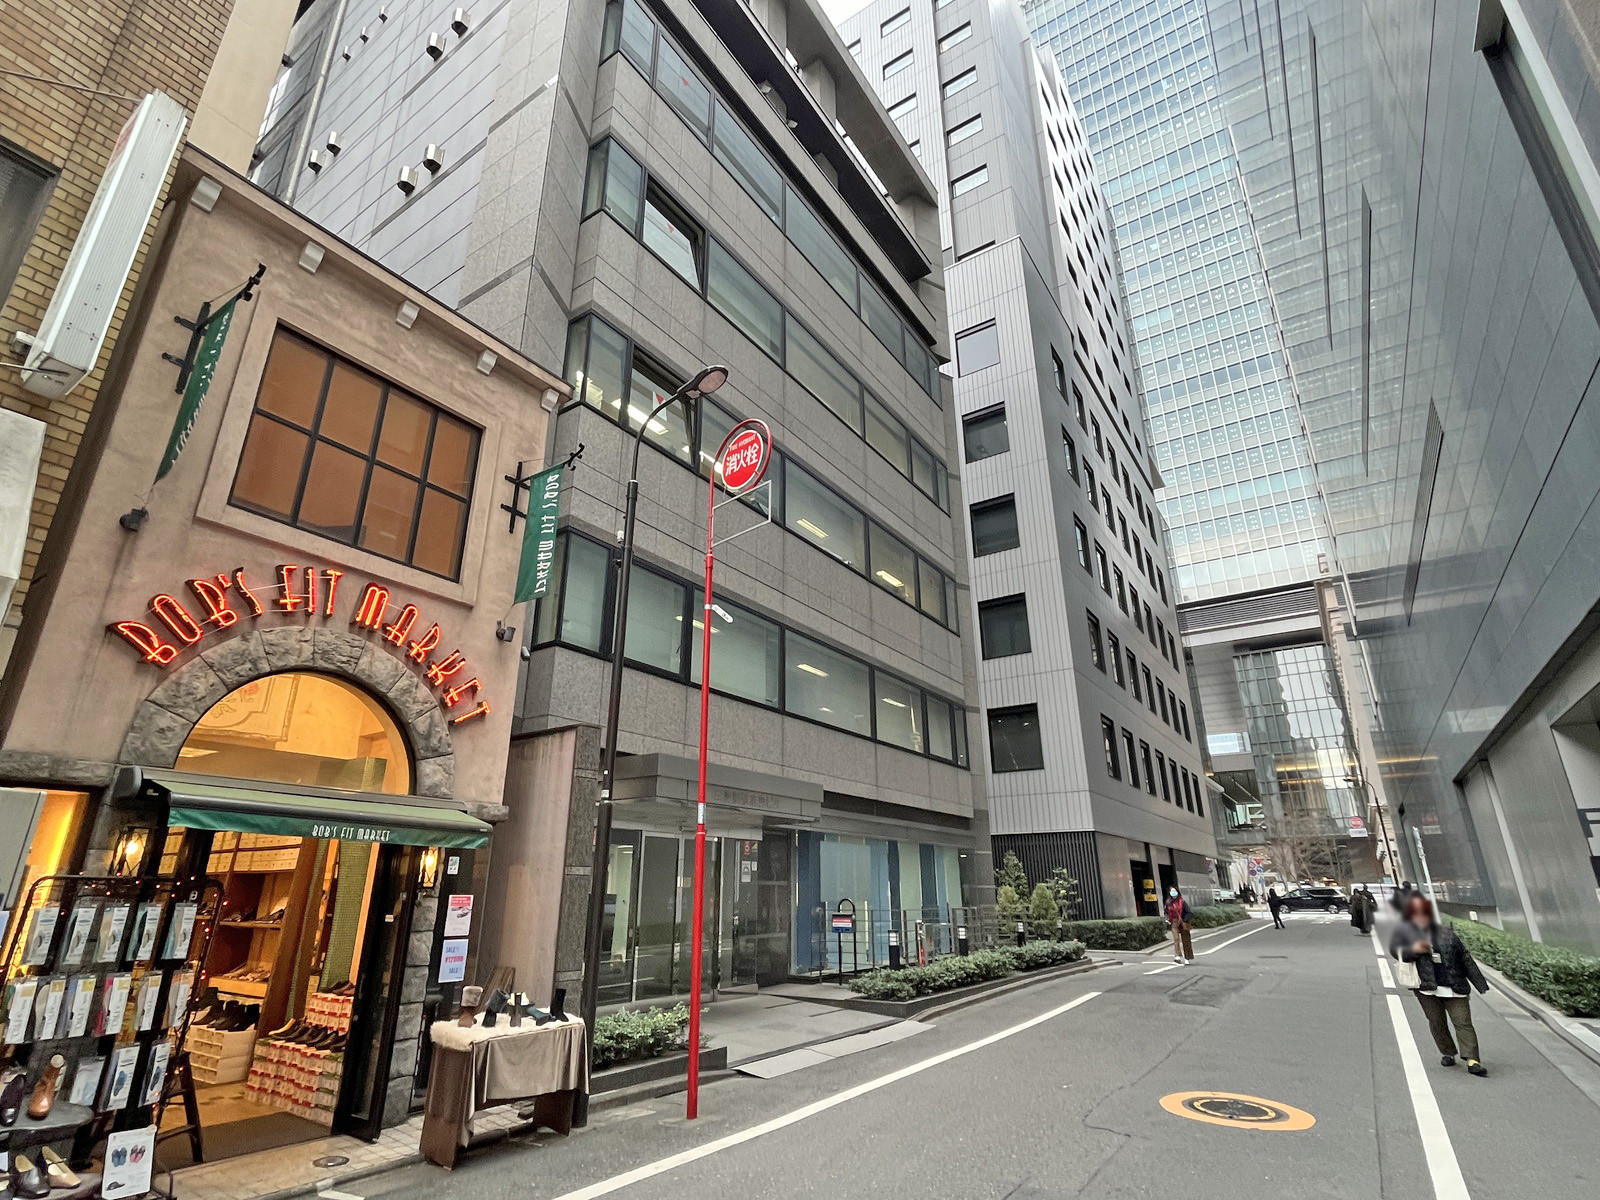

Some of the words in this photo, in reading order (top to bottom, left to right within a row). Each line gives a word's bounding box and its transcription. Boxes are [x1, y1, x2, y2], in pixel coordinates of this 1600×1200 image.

[725, 443, 759, 476] 消火栓
[540, 515, 555, 534] FIT
[534, 540, 554, 593] MARKET
[108, 567, 263, 666] BOB'S
[275, 564, 344, 617] FIT
[351, 581, 491, 726] MARKET
[312, 824, 337, 838] BOB'S
[340, 827, 354, 839] FIT
[356, 828, 391, 842] MARKET
